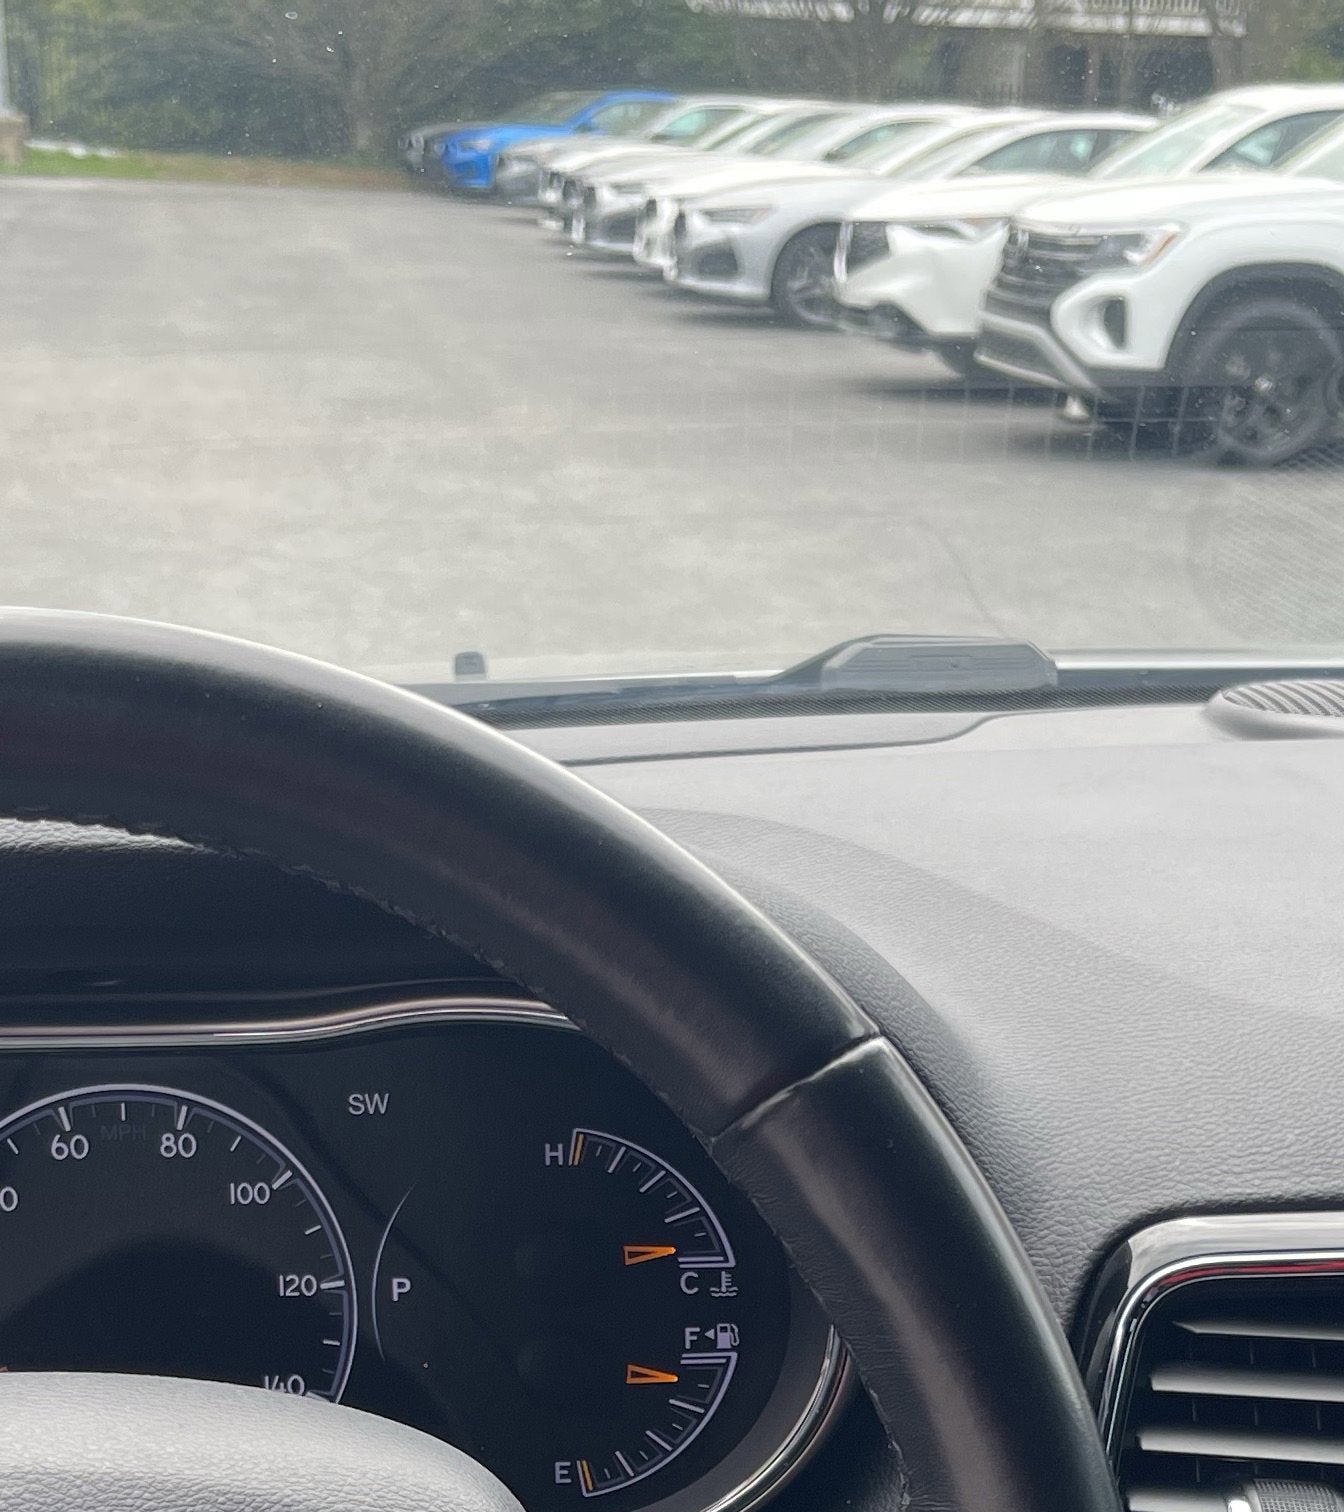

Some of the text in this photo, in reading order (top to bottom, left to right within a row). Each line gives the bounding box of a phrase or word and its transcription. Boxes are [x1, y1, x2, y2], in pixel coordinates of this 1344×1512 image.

[348, 1092, 390, 1115] SW
[50, 1134, 89, 1161] 60
[159, 1132, 197, 1158] 80
[544, 1143, 564, 1166] H
[229, 1182, 271, 1205] 100
[279, 1274, 318, 1297] 120
[391, 1277, 411, 1302] P
[680, 1271, 699, 1295] C
[684, 1326, 701, 1350] F
[554, 1461, 572, 1484] E
